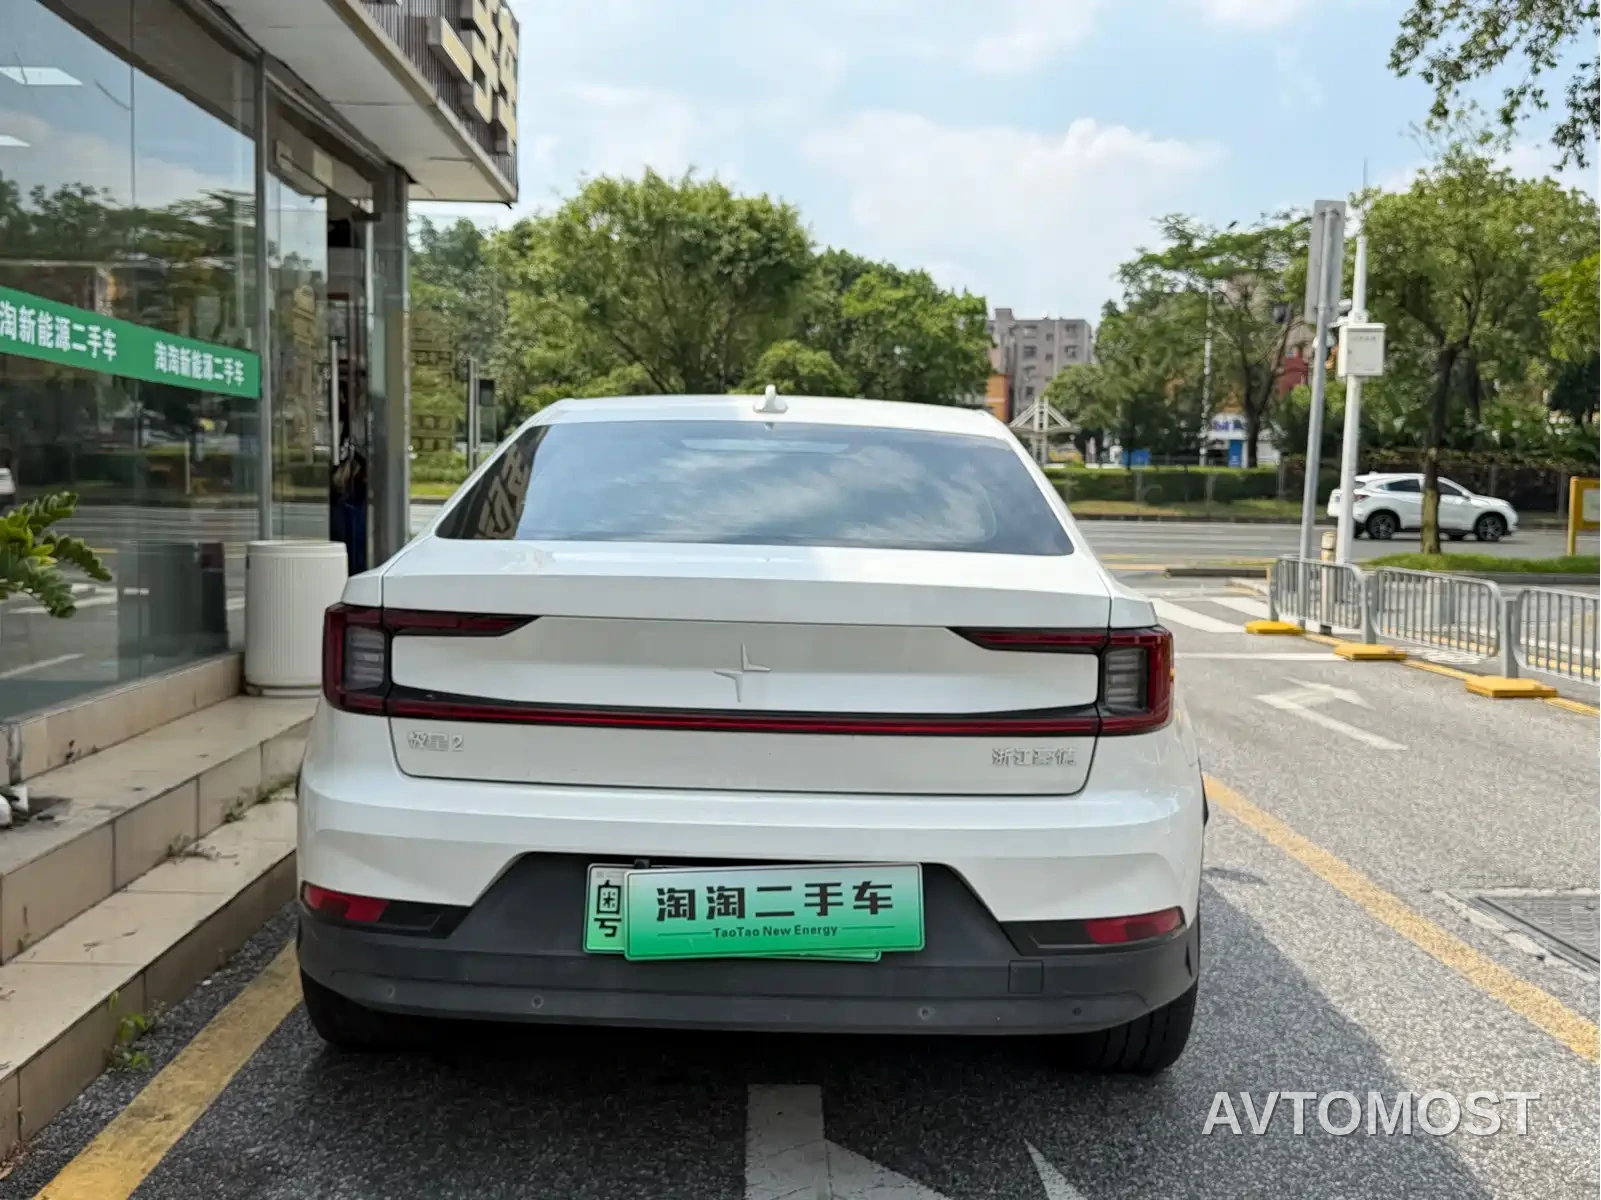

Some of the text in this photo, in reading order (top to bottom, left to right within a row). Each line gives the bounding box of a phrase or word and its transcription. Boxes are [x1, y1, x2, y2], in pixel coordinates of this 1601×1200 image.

[154, 340, 245, 386] 淘淘新能源二手车
[452, 734, 465, 752] 2
[656, 881, 894, 921] 淘淘二手车
[713, 924, 839, 938] TaoTao New Energy
